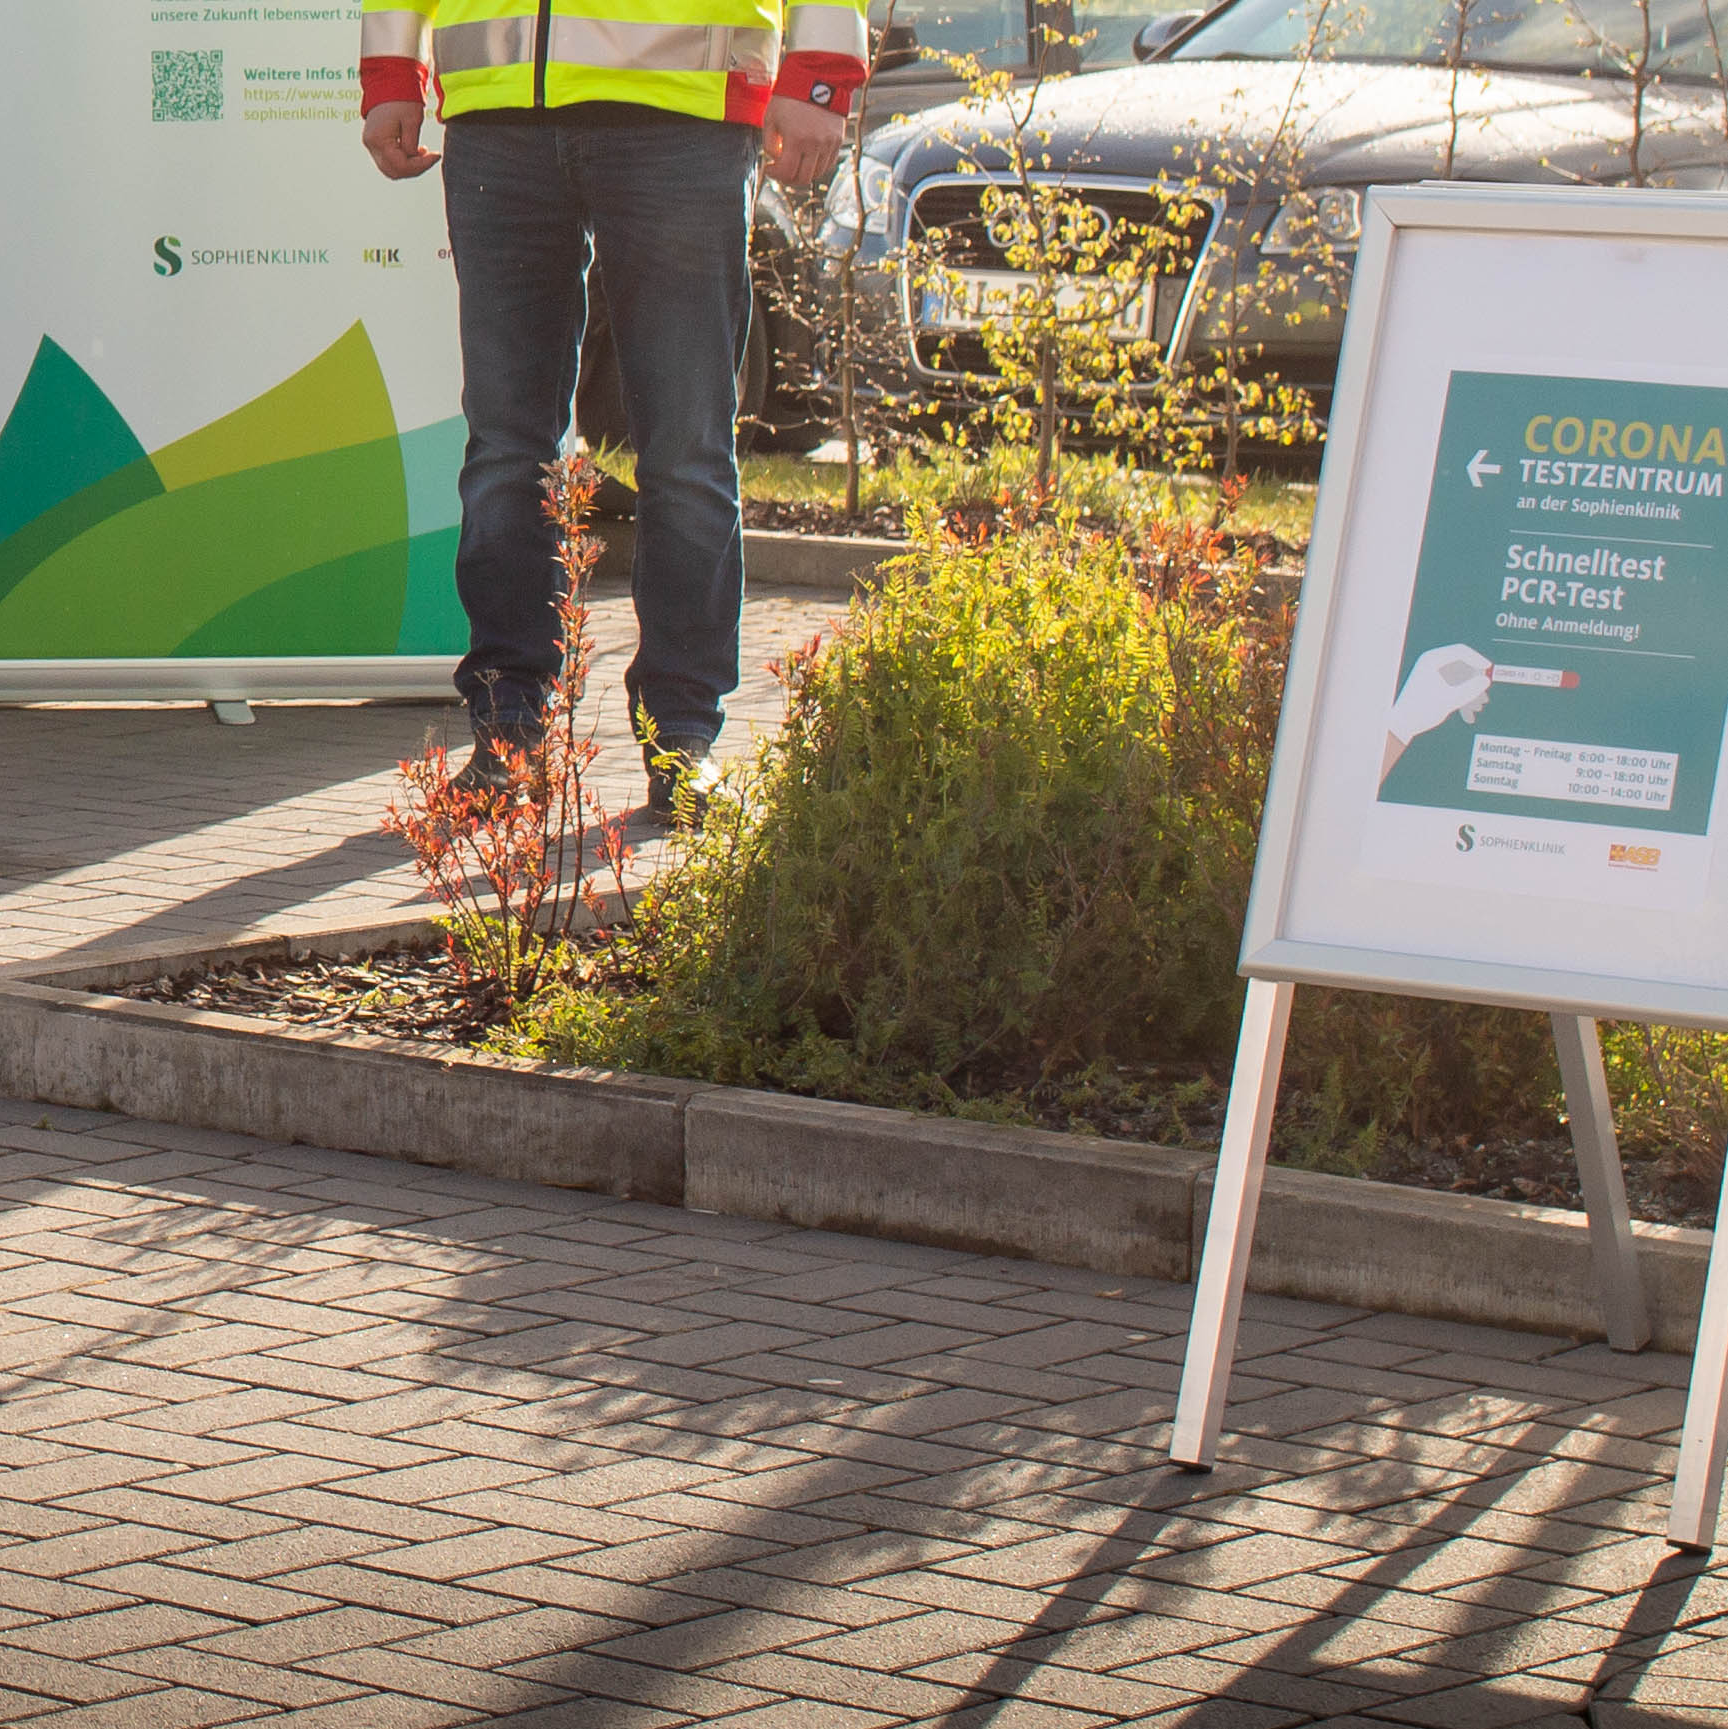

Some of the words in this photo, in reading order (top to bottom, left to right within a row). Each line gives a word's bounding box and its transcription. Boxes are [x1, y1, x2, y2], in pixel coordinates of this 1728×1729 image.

[150, 9, 199, 22] unsere
[202, 7, 260, 22] Zukunft
[263, 6, 342, 21] lebenswert
[243, 67, 302, 82] Weitere
[306, 66, 343, 81] Infos
[191, 248, 330, 266] SOPHIENKLINIK
[1523, 413, 1727, 467] CORONA
[1518, 458, 1724, 498] TESTZENTRUM
[1516, 496, 1537, 509] an
[1539, 494, 1569, 511] der
[1570, 497, 1682, 521] Sophienklinik
[1504, 543, 1666, 582] Schnelltest
[1500, 575, 1626, 612] PCR-Test
[1495, 611, 1539, 631] Ohne
[1541, 615, 1641, 643] Anmeldung!
[1478, 740, 1522, 758] Montag
[1533, 746, 1574, 763] Freitag
[1578, 751, 1606, 765] 6:00
[1616, 755, 1648, 769] 18:00
[1650, 758, 1672, 771] Uhr
[1475, 757, 1523, 774] Samstag
[1575, 767, 1603, 780] 9:00
[1613, 770, 1645, 784] 18:00
[1647, 774, 1670, 786] Uhr
[1472, 772, 1519, 790] Sonntag
[1568, 782, 1600, 796] 10:00
[1609, 786, 1642, 801] 14:00
[1644, 790, 1668, 803] Uhr
[1479, 835, 1567, 856] SOPHIENKLINIK
